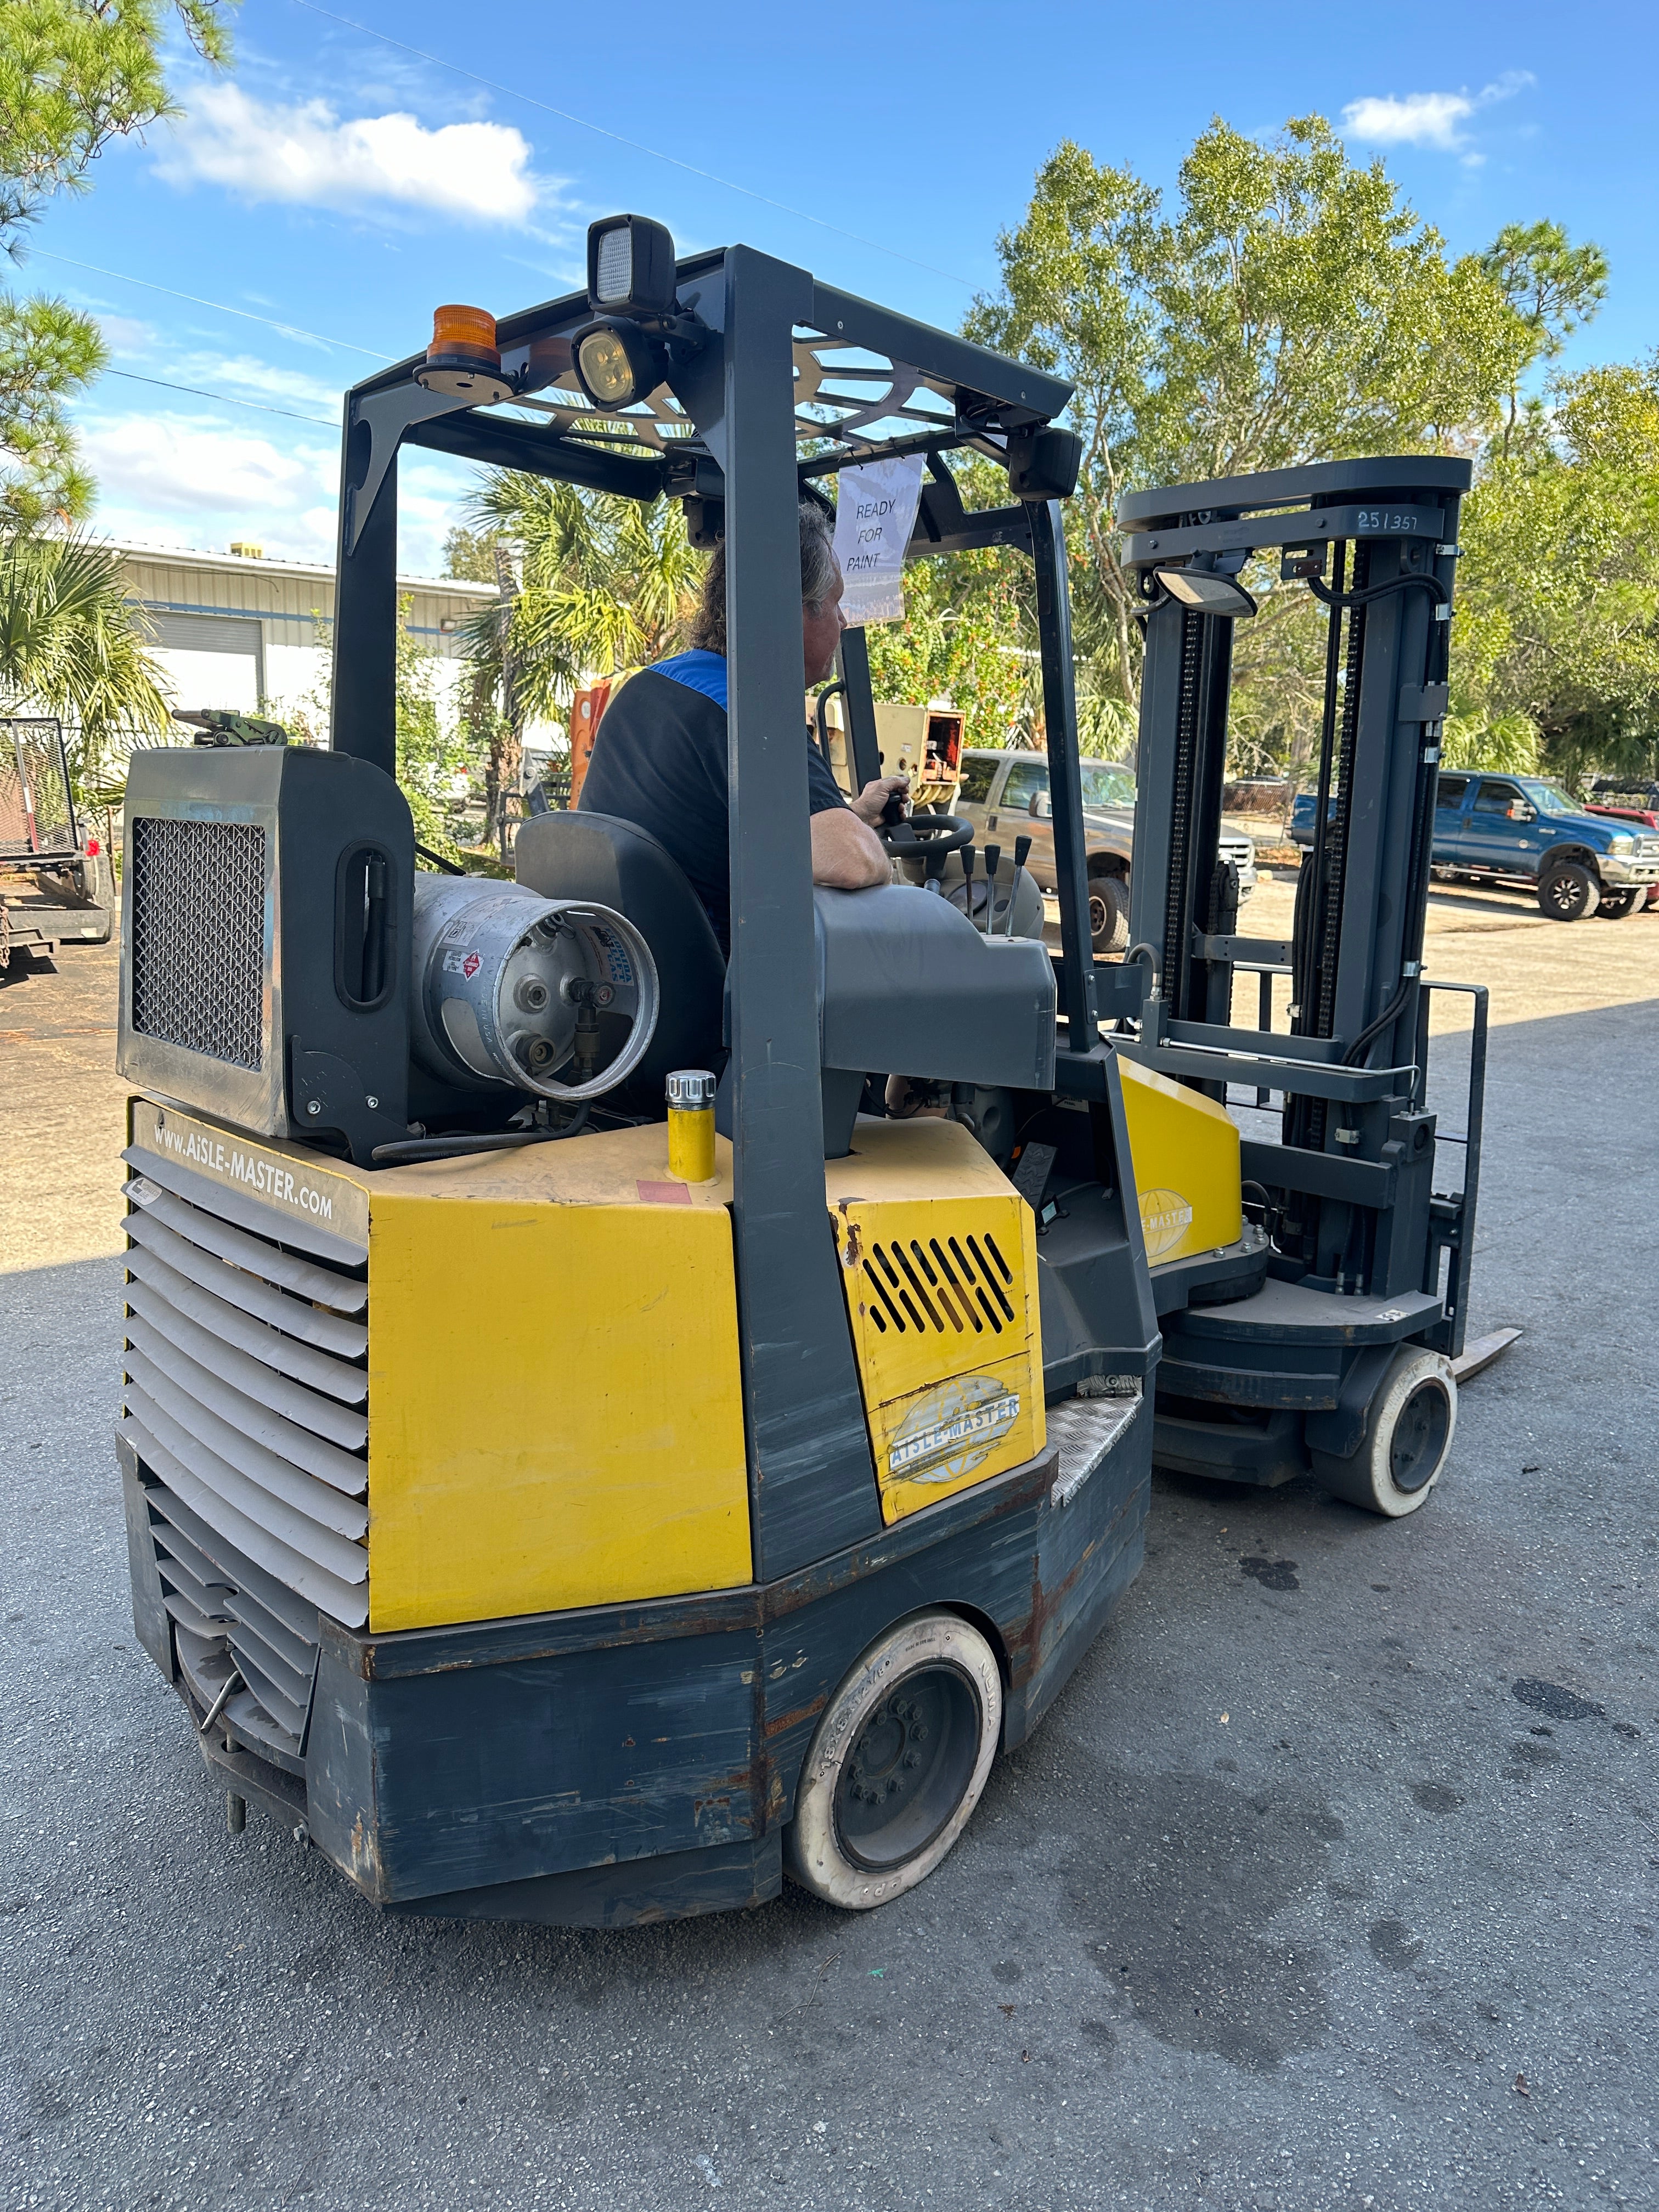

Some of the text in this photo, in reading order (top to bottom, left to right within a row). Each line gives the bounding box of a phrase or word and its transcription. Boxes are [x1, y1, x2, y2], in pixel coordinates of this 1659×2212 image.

[856, 499, 896, 520] READY
[857, 527, 882, 544] FOR
[847, 553, 881, 571] PAINT
[605, 928, 632, 983] FLORIDA
[611, 949, 625, 983] LIFT
[607, 954, 618, 982] GAS
